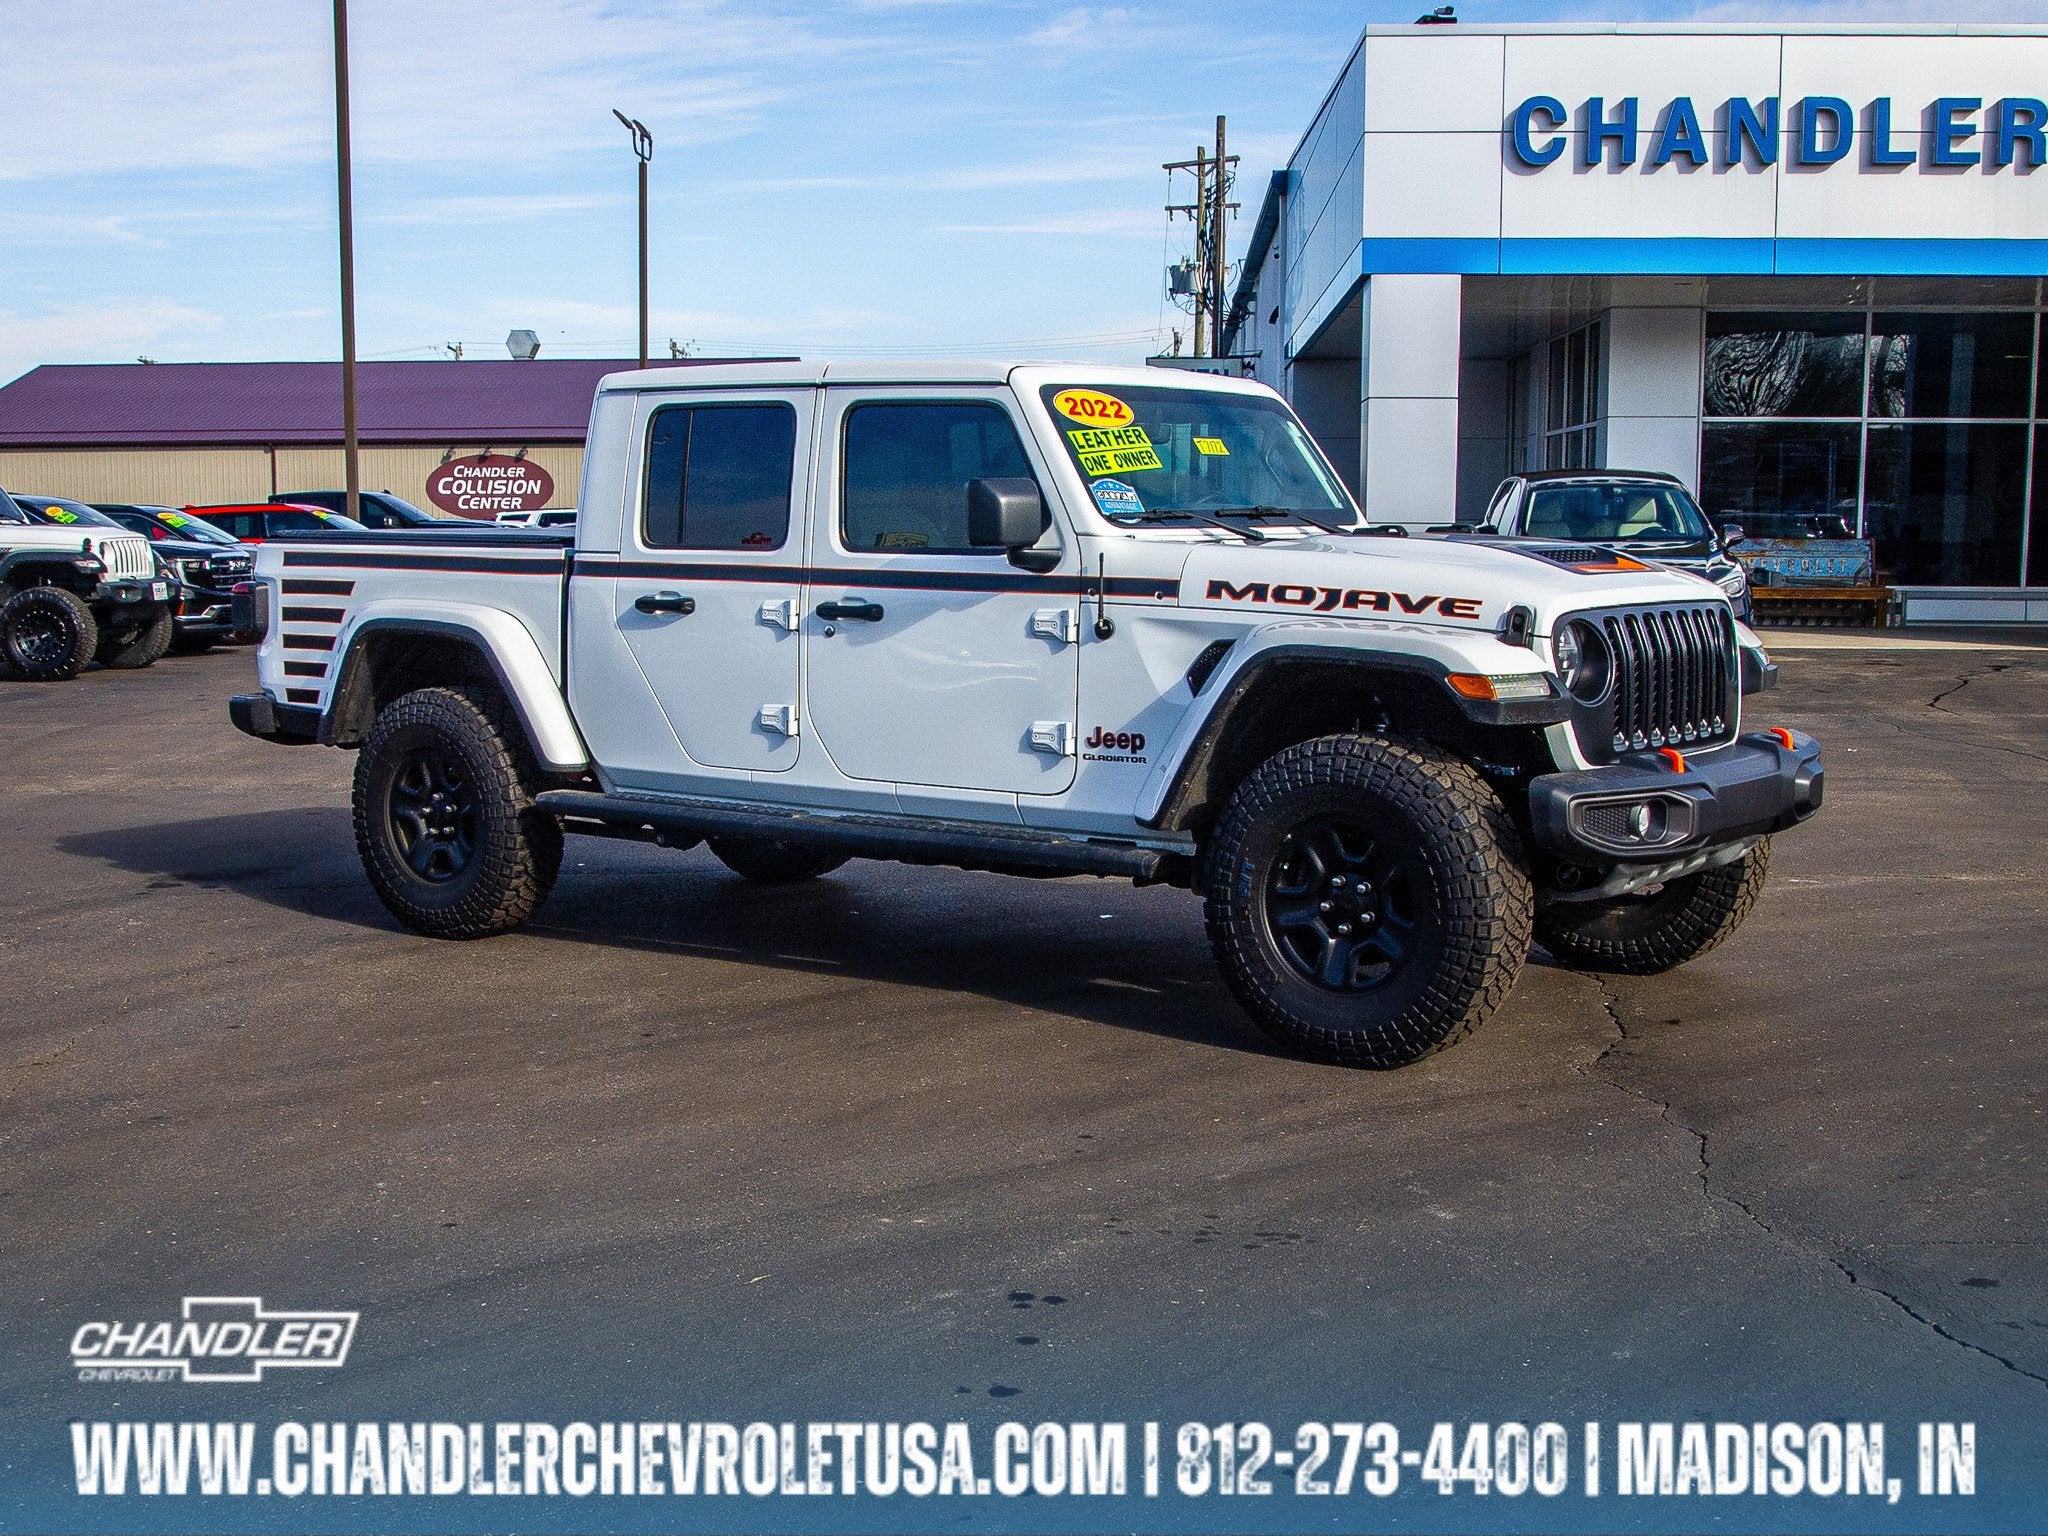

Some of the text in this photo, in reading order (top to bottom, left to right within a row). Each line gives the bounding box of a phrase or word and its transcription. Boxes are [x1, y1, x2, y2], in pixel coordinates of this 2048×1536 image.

[1512, 95, 2048, 166] CHANDLER
[1064, 397, 1126, 419] 2022
[1072, 428, 1148, 450] LEATHER
[1084, 451, 1158, 473] ONE OWNER
[437, 477, 542, 495] COLLISION
[457, 495, 523, 510] CENTER
[1205, 579, 1484, 620] MOJAVE
[1085, 726, 1146, 754] Jeep
[1082, 753, 1148, 764] GLADIATOR
